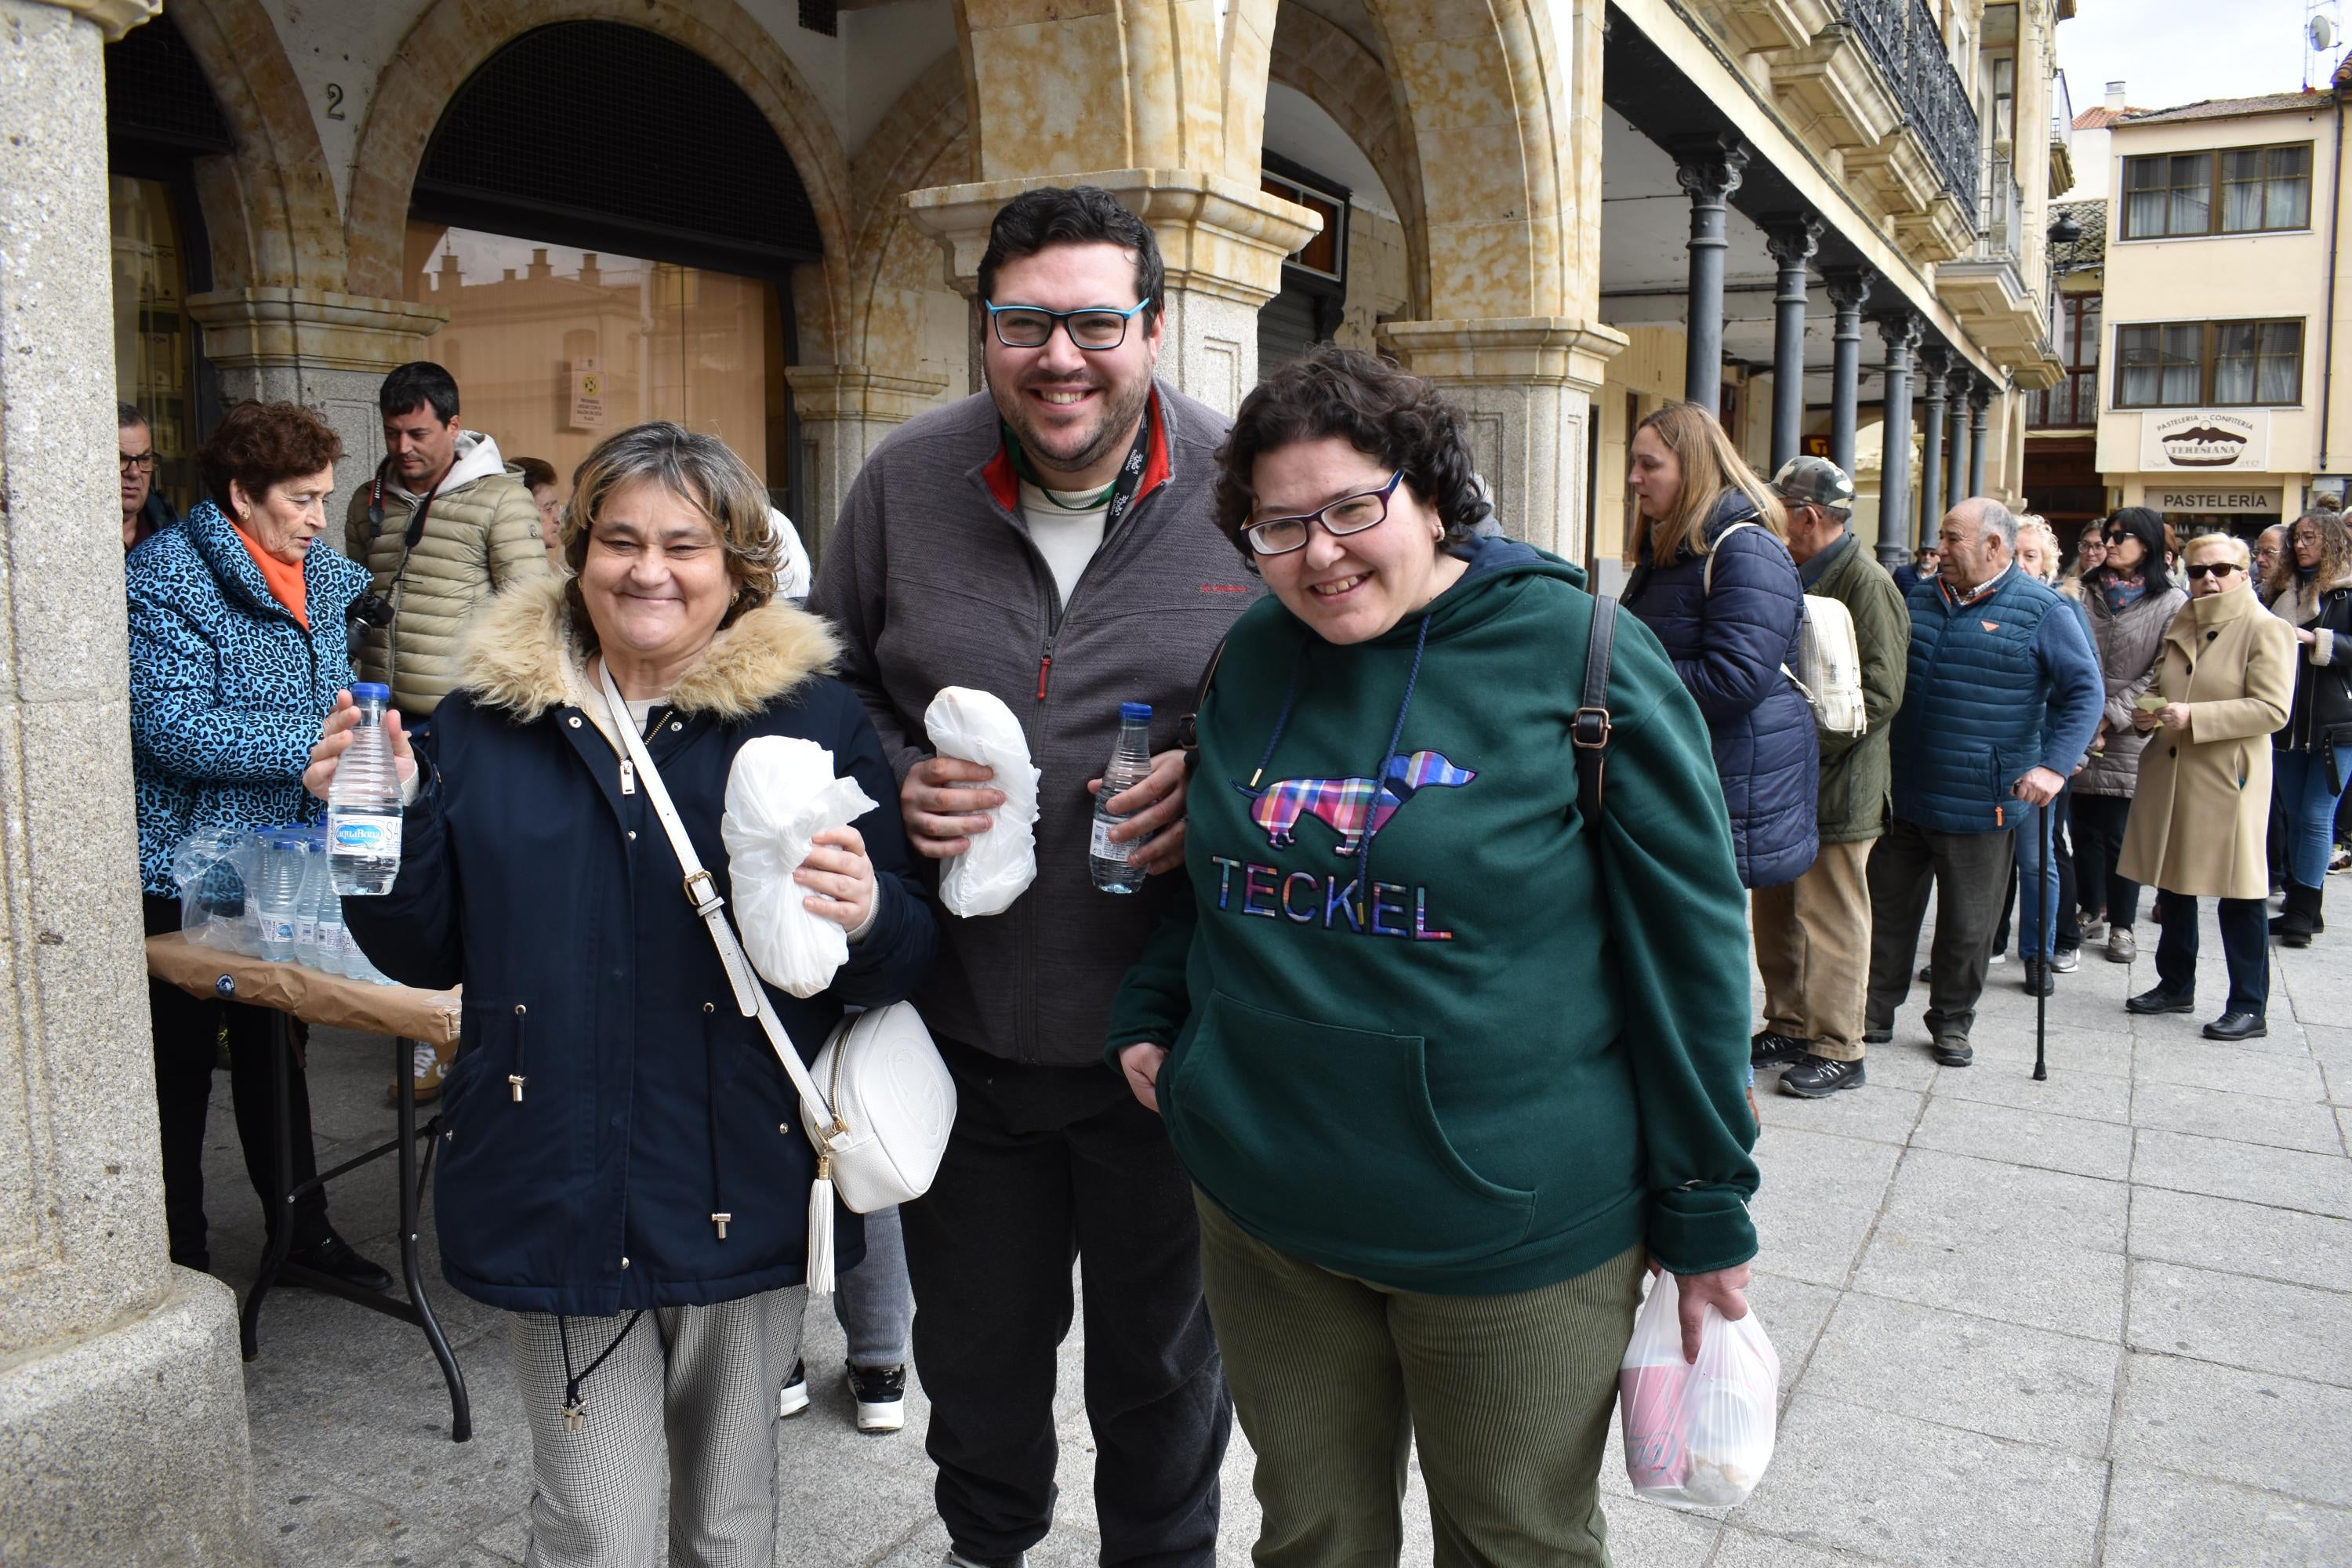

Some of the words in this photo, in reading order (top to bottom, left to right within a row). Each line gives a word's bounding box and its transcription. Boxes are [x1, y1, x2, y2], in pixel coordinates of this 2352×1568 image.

[327, 82, 346, 121] 2
[2170, 445, 2235, 455] TERESIANA
[2163, 492, 2268, 507] PASTELERÍA
[1211, 854, 1454, 941] TECKEL
